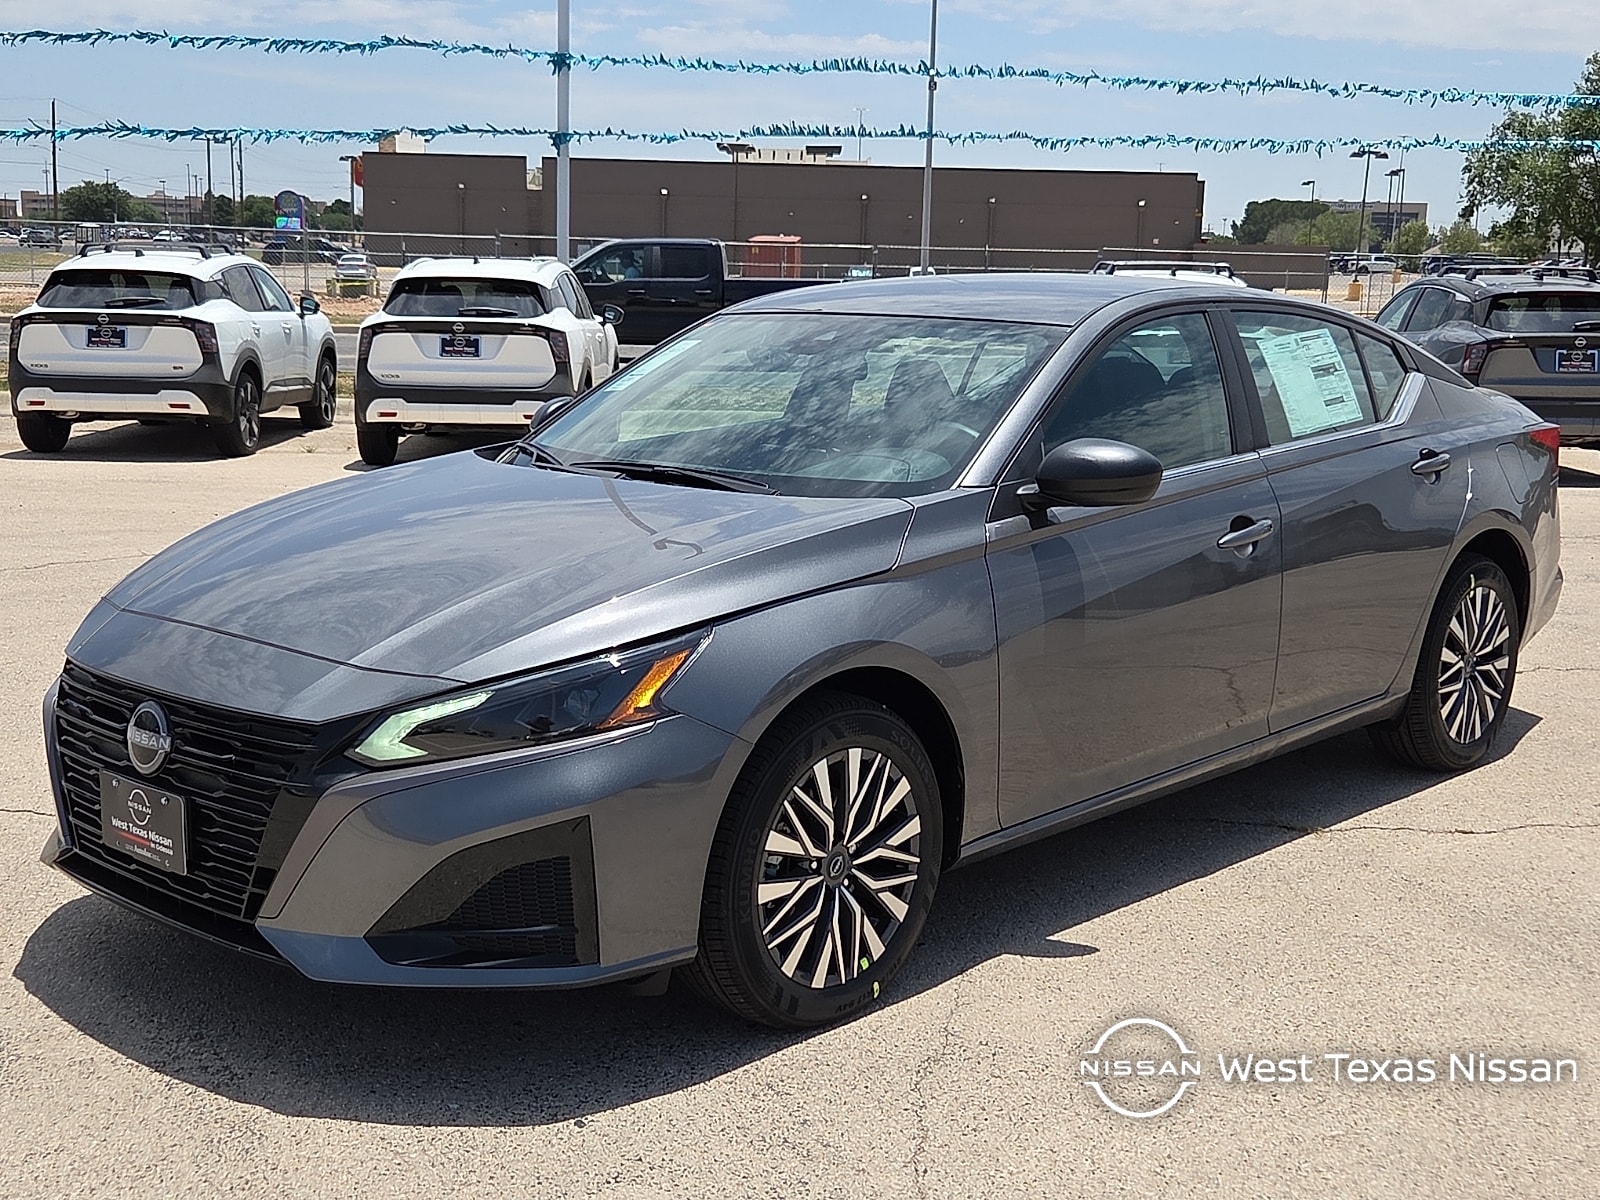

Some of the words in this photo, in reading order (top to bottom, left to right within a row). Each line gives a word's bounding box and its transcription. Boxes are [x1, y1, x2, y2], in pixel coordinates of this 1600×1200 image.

[128, 725, 170, 749] NISSAN
[128, 800, 151, 814] NISSAN
[111, 816, 128, 831] West
[128, 823, 148, 839] Texas
[148, 831, 173, 848] Nissan
[739, 828, 761, 925] KUMHO
